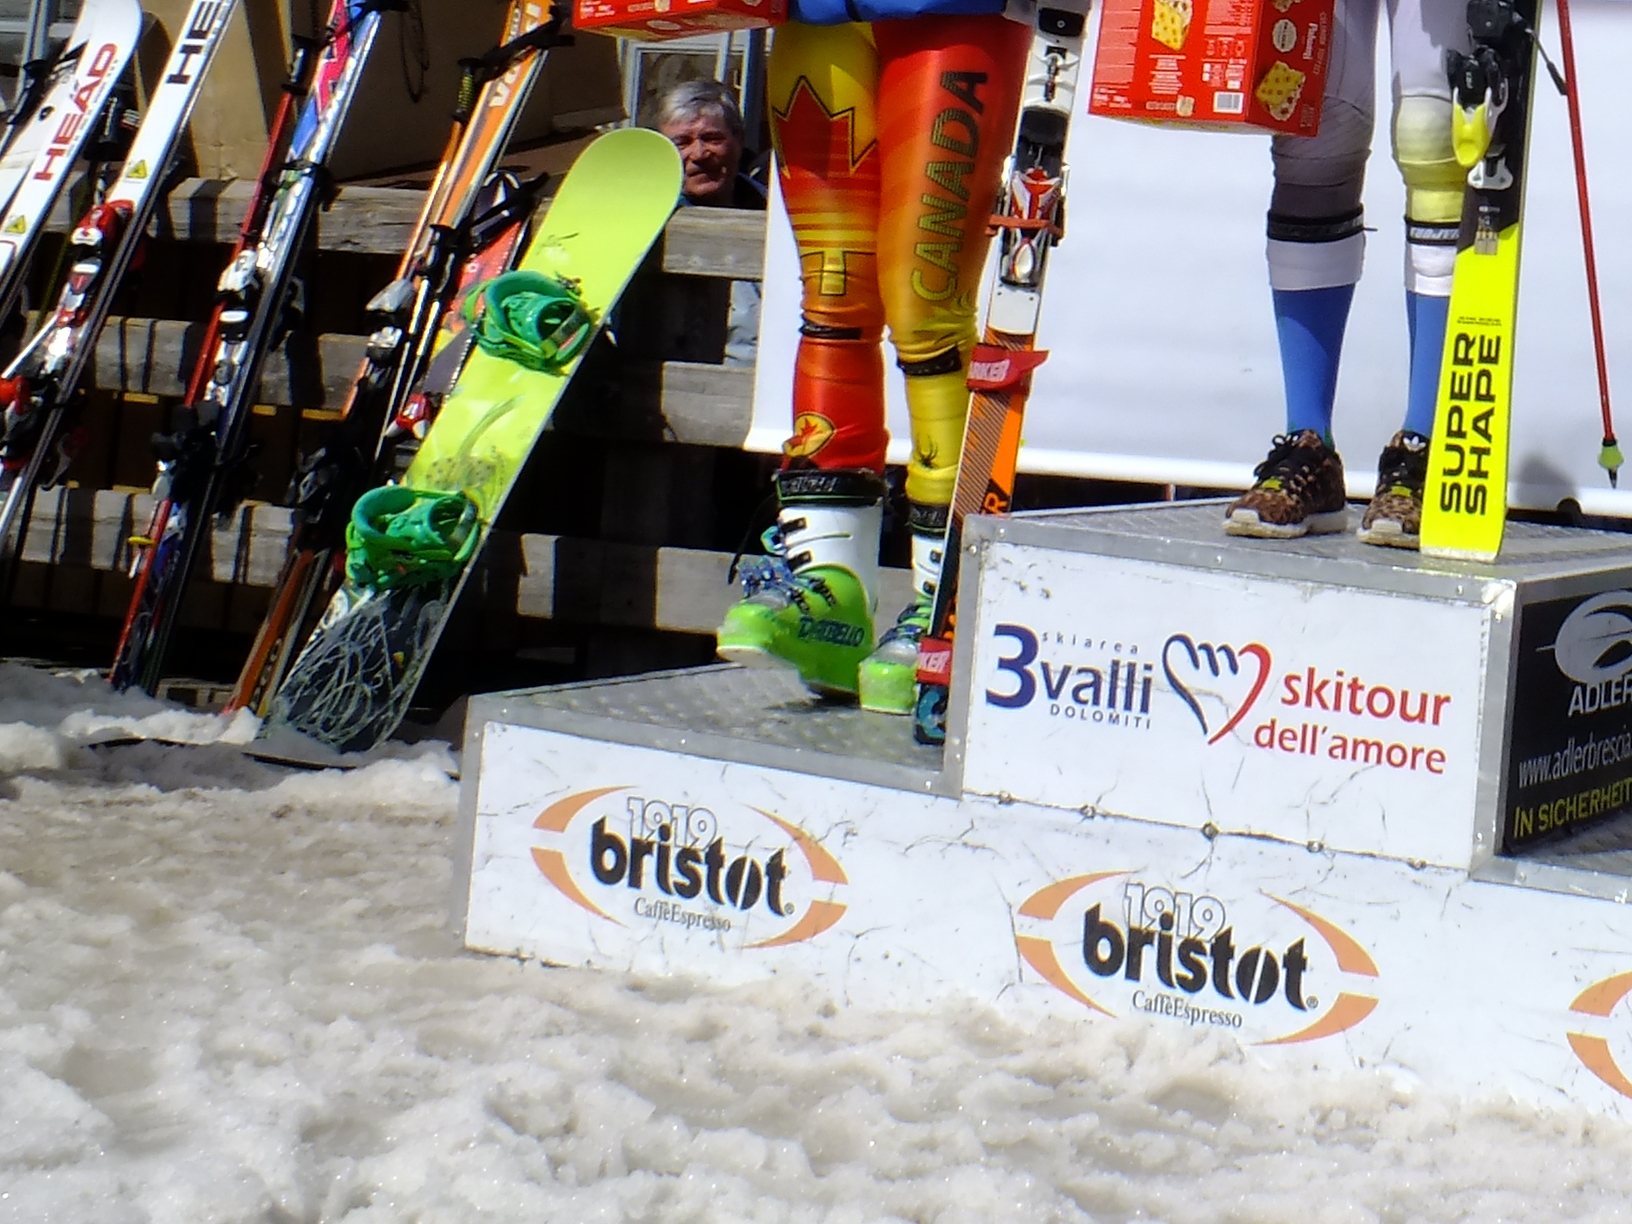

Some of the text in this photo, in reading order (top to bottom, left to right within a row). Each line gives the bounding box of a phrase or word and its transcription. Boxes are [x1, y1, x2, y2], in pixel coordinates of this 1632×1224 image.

[33, 42, 118, 181] HEAD
[910, 70, 988, 302] CANADA
[1440, 331, 1478, 514] SUPER
[1464, 334, 1502, 516] SHAPE
[1041, 630, 1140, 655] skiarea
[1049, 703, 1151, 730] DOLOMITI
[1280, 666, 1452, 726] skitour
[1253, 718, 1448, 775] dell'amore
[627, 796, 718, 851] 1919
[1514, 806, 1534, 839] IN
[1538, 776, 1632, 832] SICHERHEIT
[590, 815, 788, 917] bristot
[1123, 883, 1227, 943] 1919
[1083, 901, 1308, 1012] bristot
